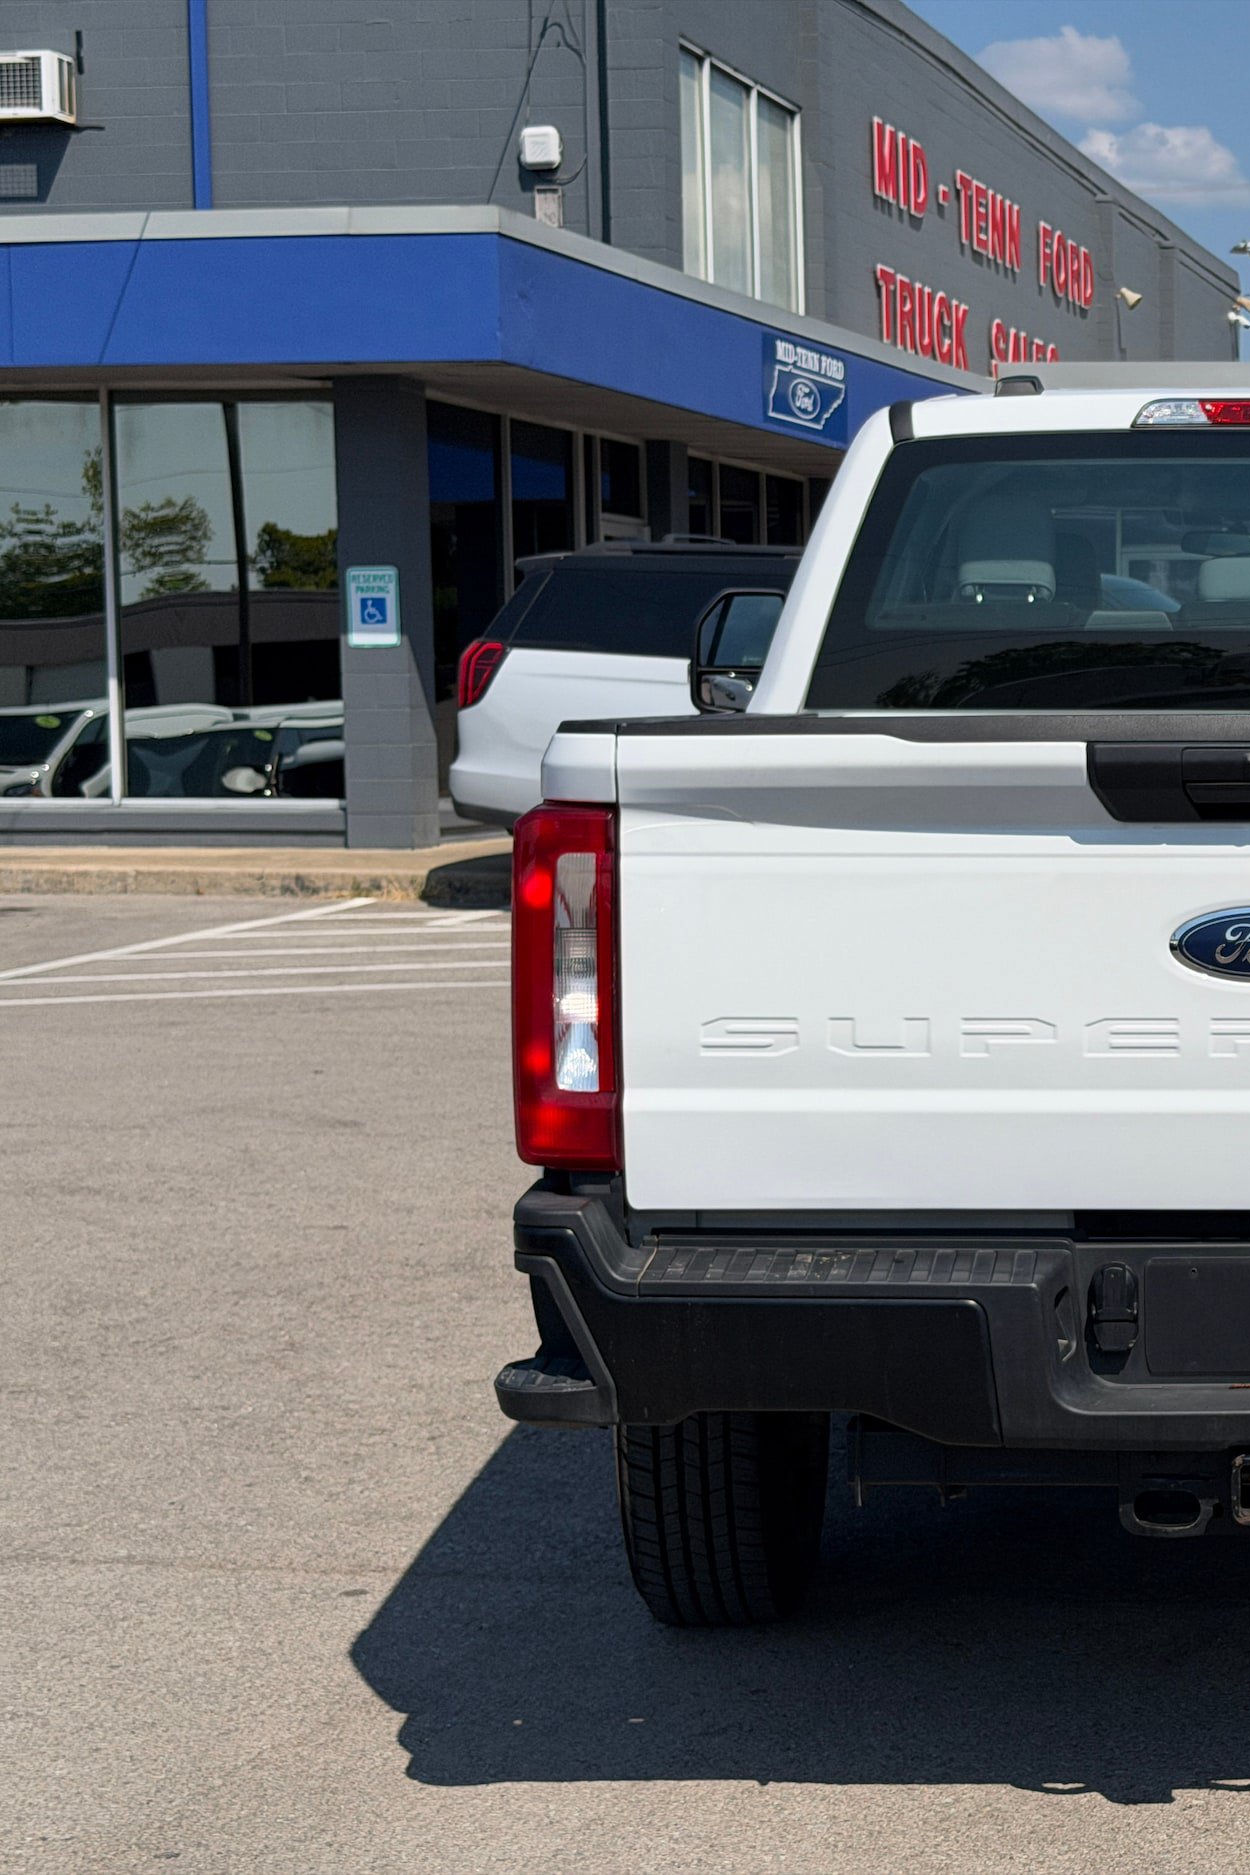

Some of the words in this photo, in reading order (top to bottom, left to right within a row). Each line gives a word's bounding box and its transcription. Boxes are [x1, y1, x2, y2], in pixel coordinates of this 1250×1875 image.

[872, 115, 929, 218] MID
[956, 169, 1021, 272] TENN
[1038, 220, 1095, 310] FORD
[876, 263, 970, 371] TRUCK
[775, 339, 820, 372] MID-TENN
[820, 355, 845, 380] FORD
[356, 586, 390, 594] PARKING
